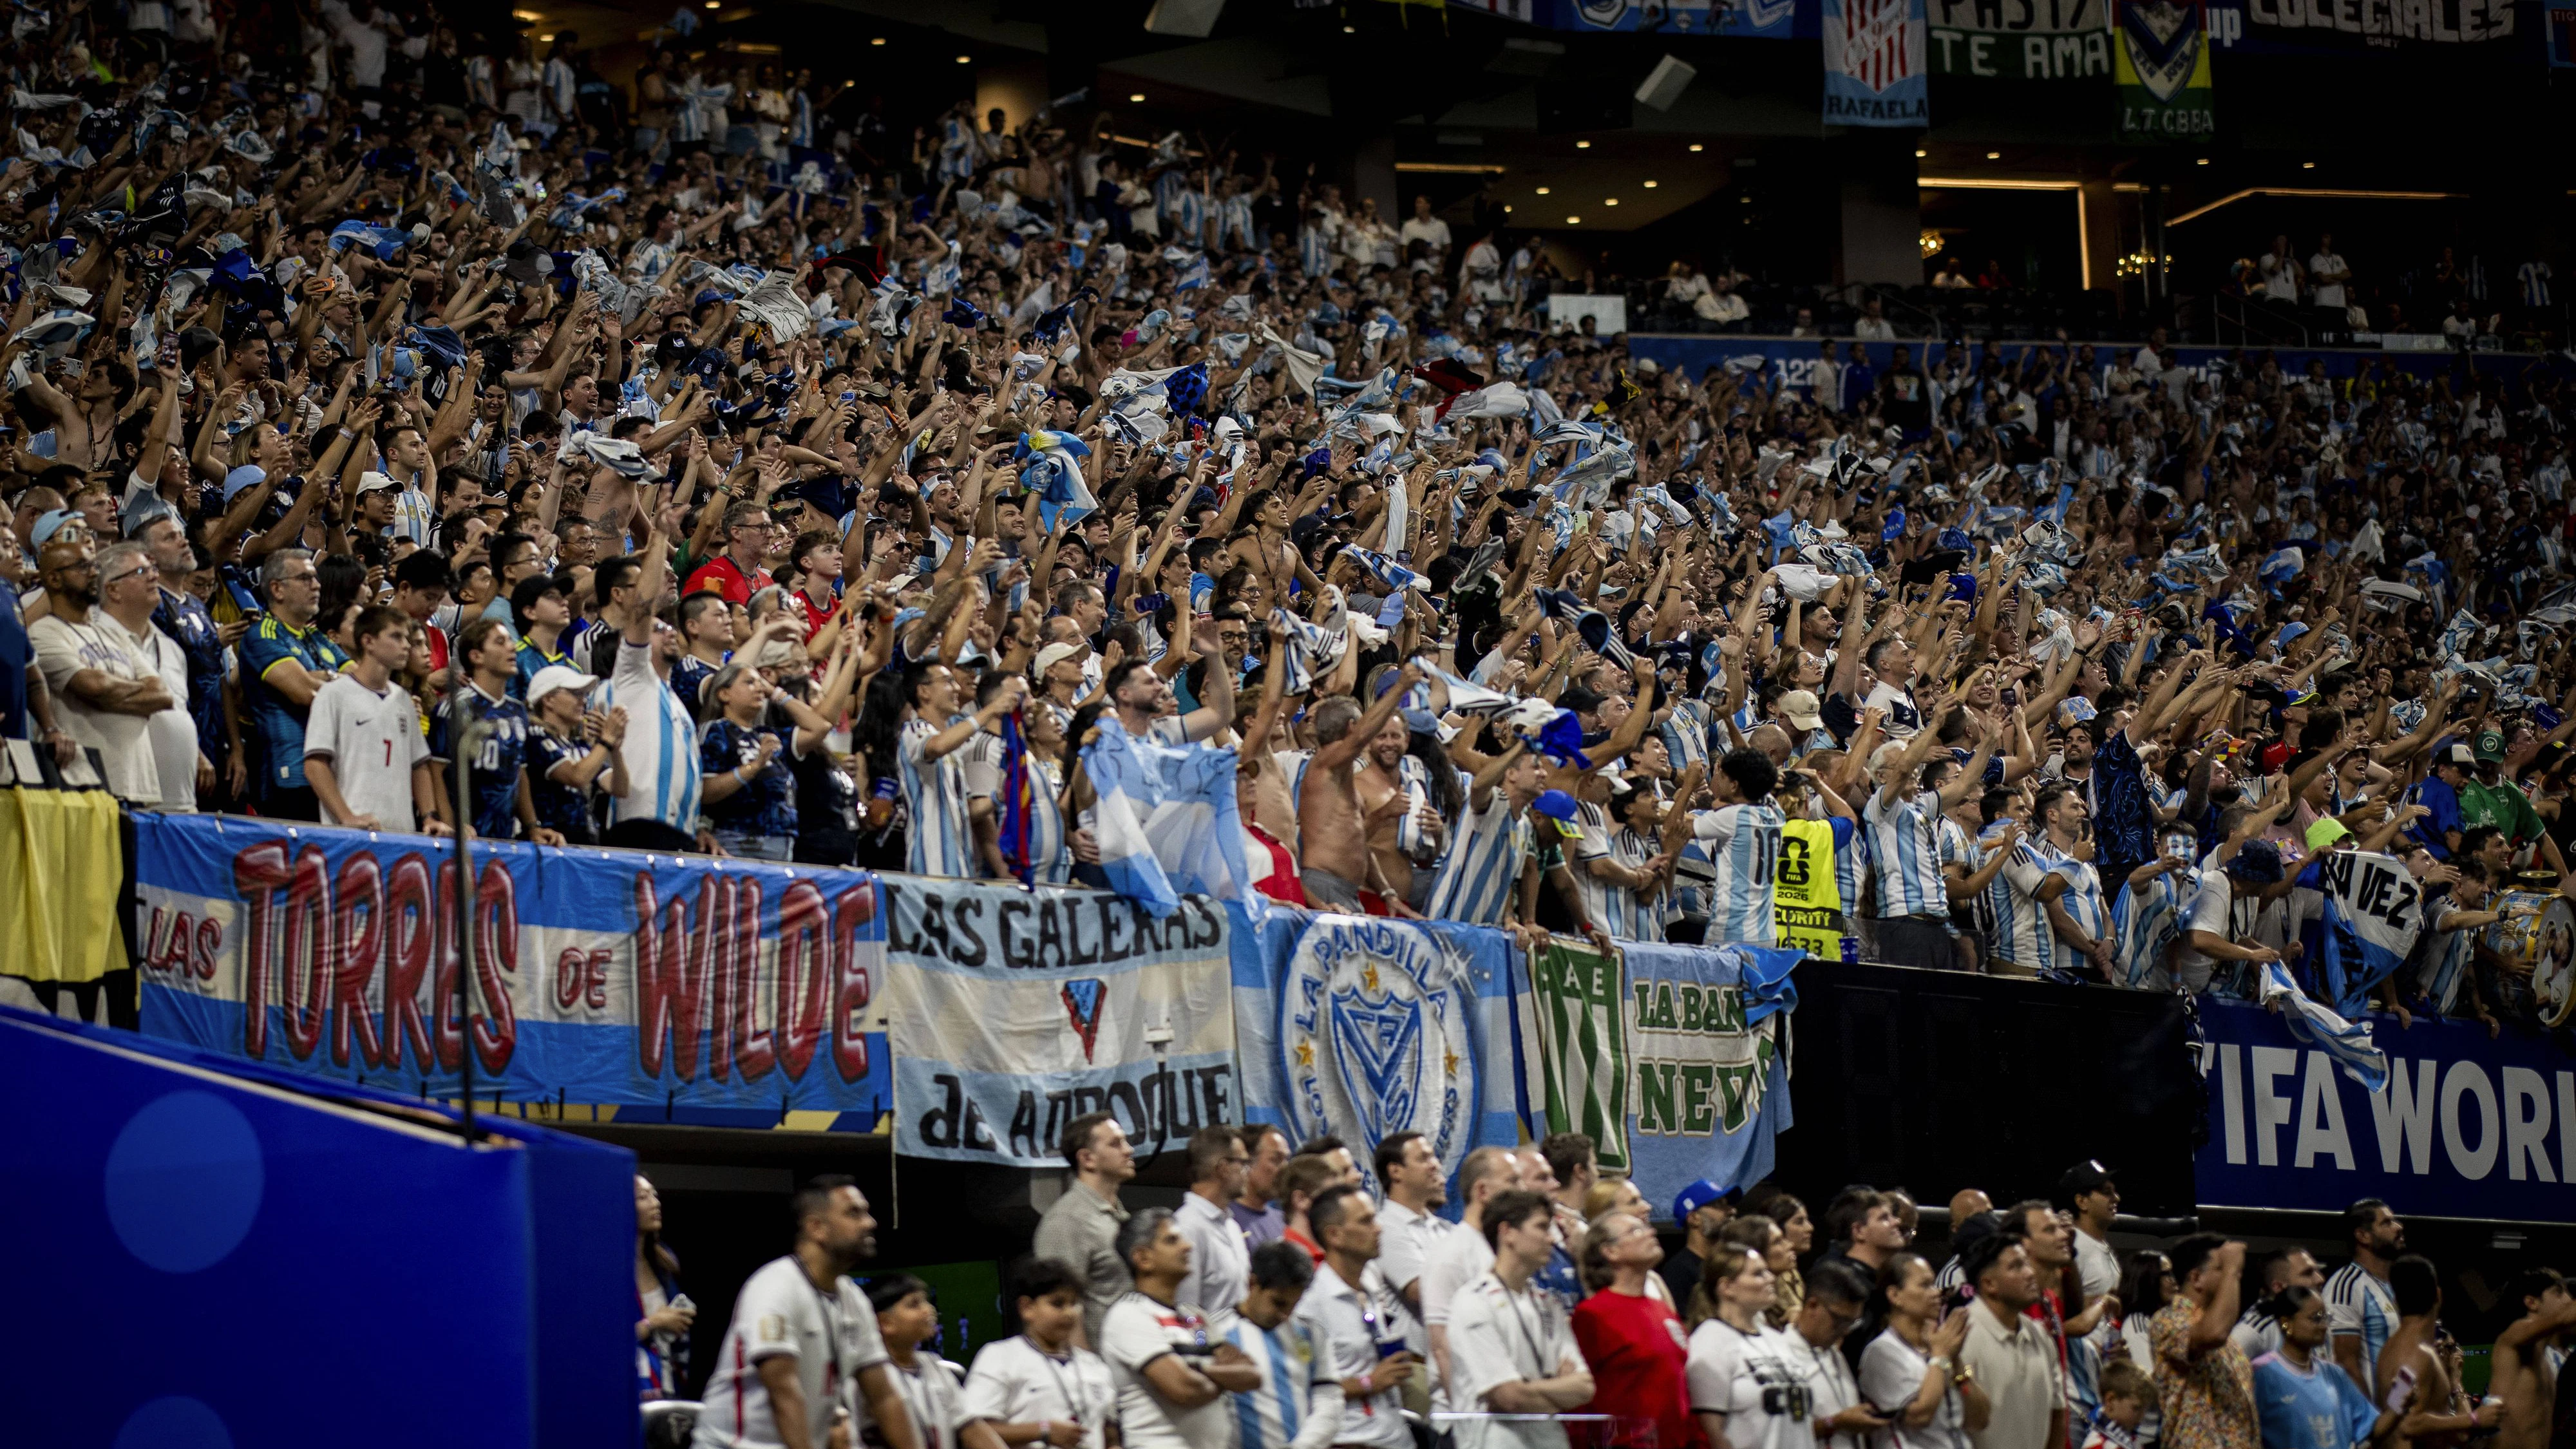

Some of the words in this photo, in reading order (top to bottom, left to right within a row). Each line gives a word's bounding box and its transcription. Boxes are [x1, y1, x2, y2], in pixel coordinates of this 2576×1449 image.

[2206, 6, 2242, 48] up
[1930, 29, 1998, 77] TE
[2023, 32, 2110, 80] AMA
[1826, 97, 1926, 118] RAFAELA
[383, 739, 392, 767] 7
[1785, 873, 1802, 882] FIFA
[1777, 891, 1809, 902] 2026
[886, 882, 988, 967] LAS
[1774, 906, 1831, 927] CURITY
[1776, 936, 1824, 957] 633
[146, 905, 223, 981] LAS
[233, 838, 518, 1077] TORRES
[557, 947, 612, 1010] DE
[634, 869, 877, 1086] WILDE
[1295, 973, 1322, 1033] LA
[1313, 921, 1448, 1020] PANDILLA
